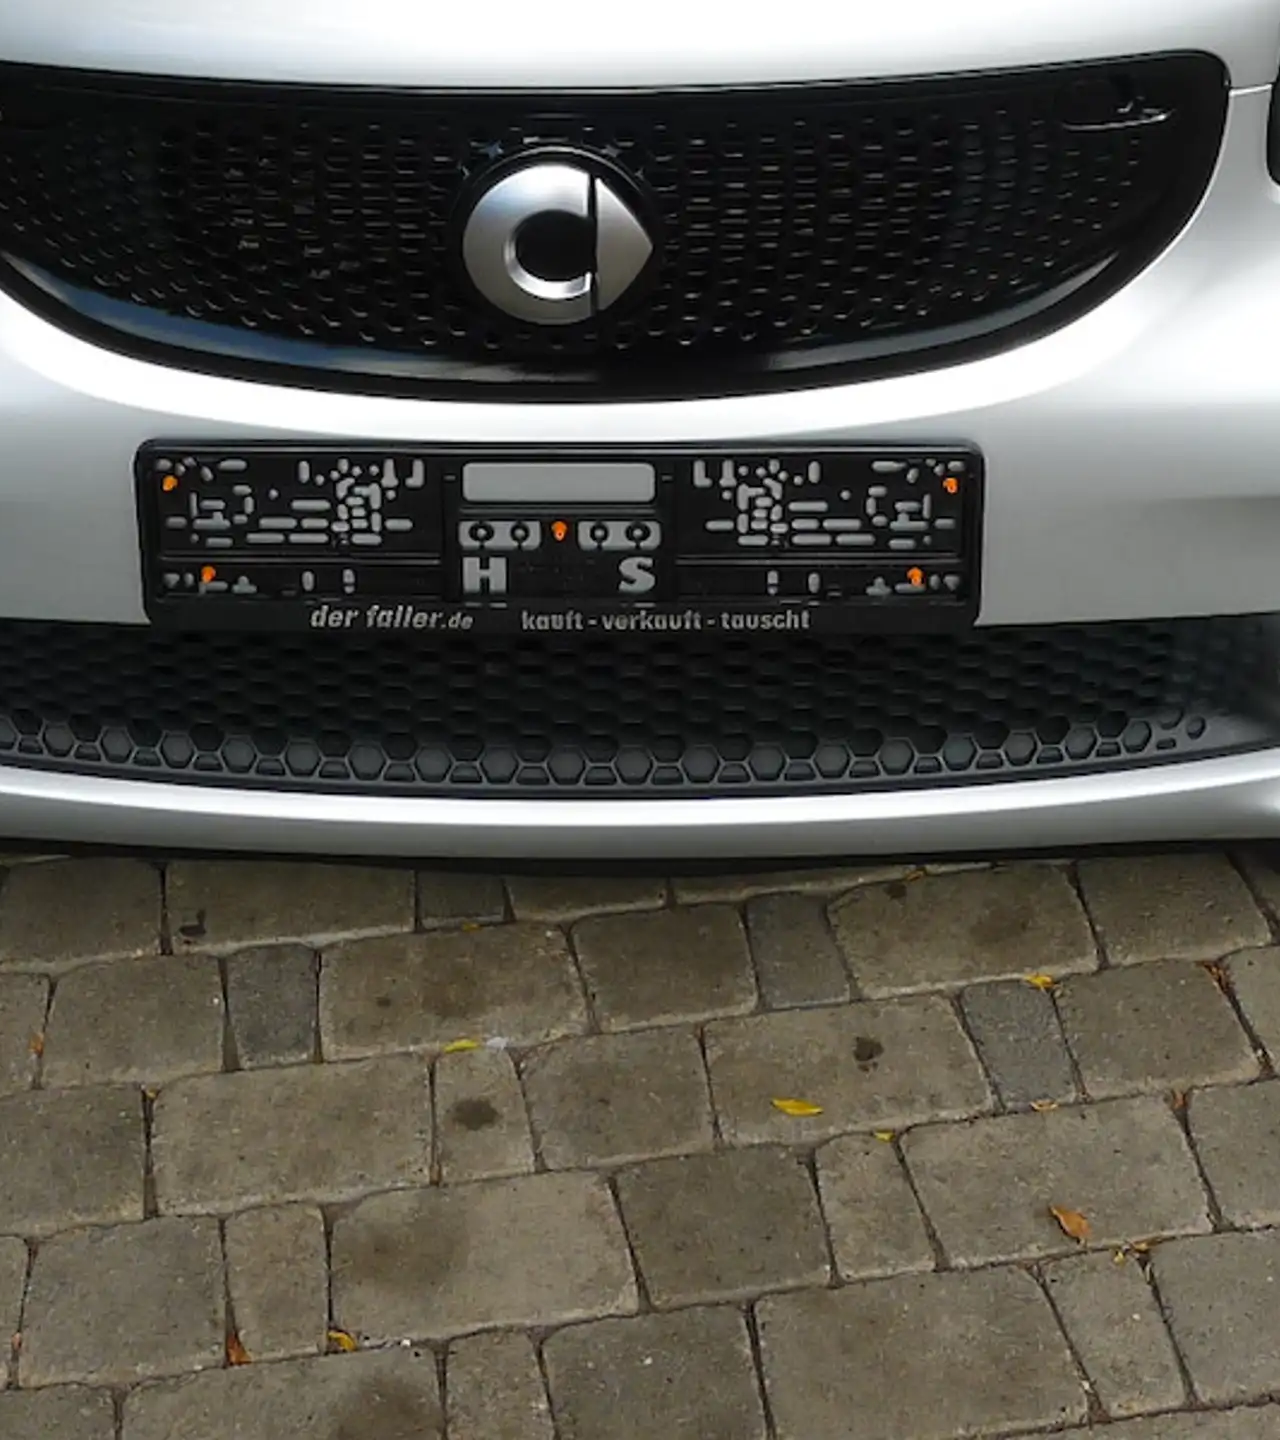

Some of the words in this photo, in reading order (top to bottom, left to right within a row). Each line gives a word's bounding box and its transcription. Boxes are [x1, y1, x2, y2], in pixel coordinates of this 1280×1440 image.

[310, 604, 358, 628] der
[521, 610, 584, 630] kauft
[601, 610, 702, 630] verkauft
[721, 610, 811, 630] tauscht
